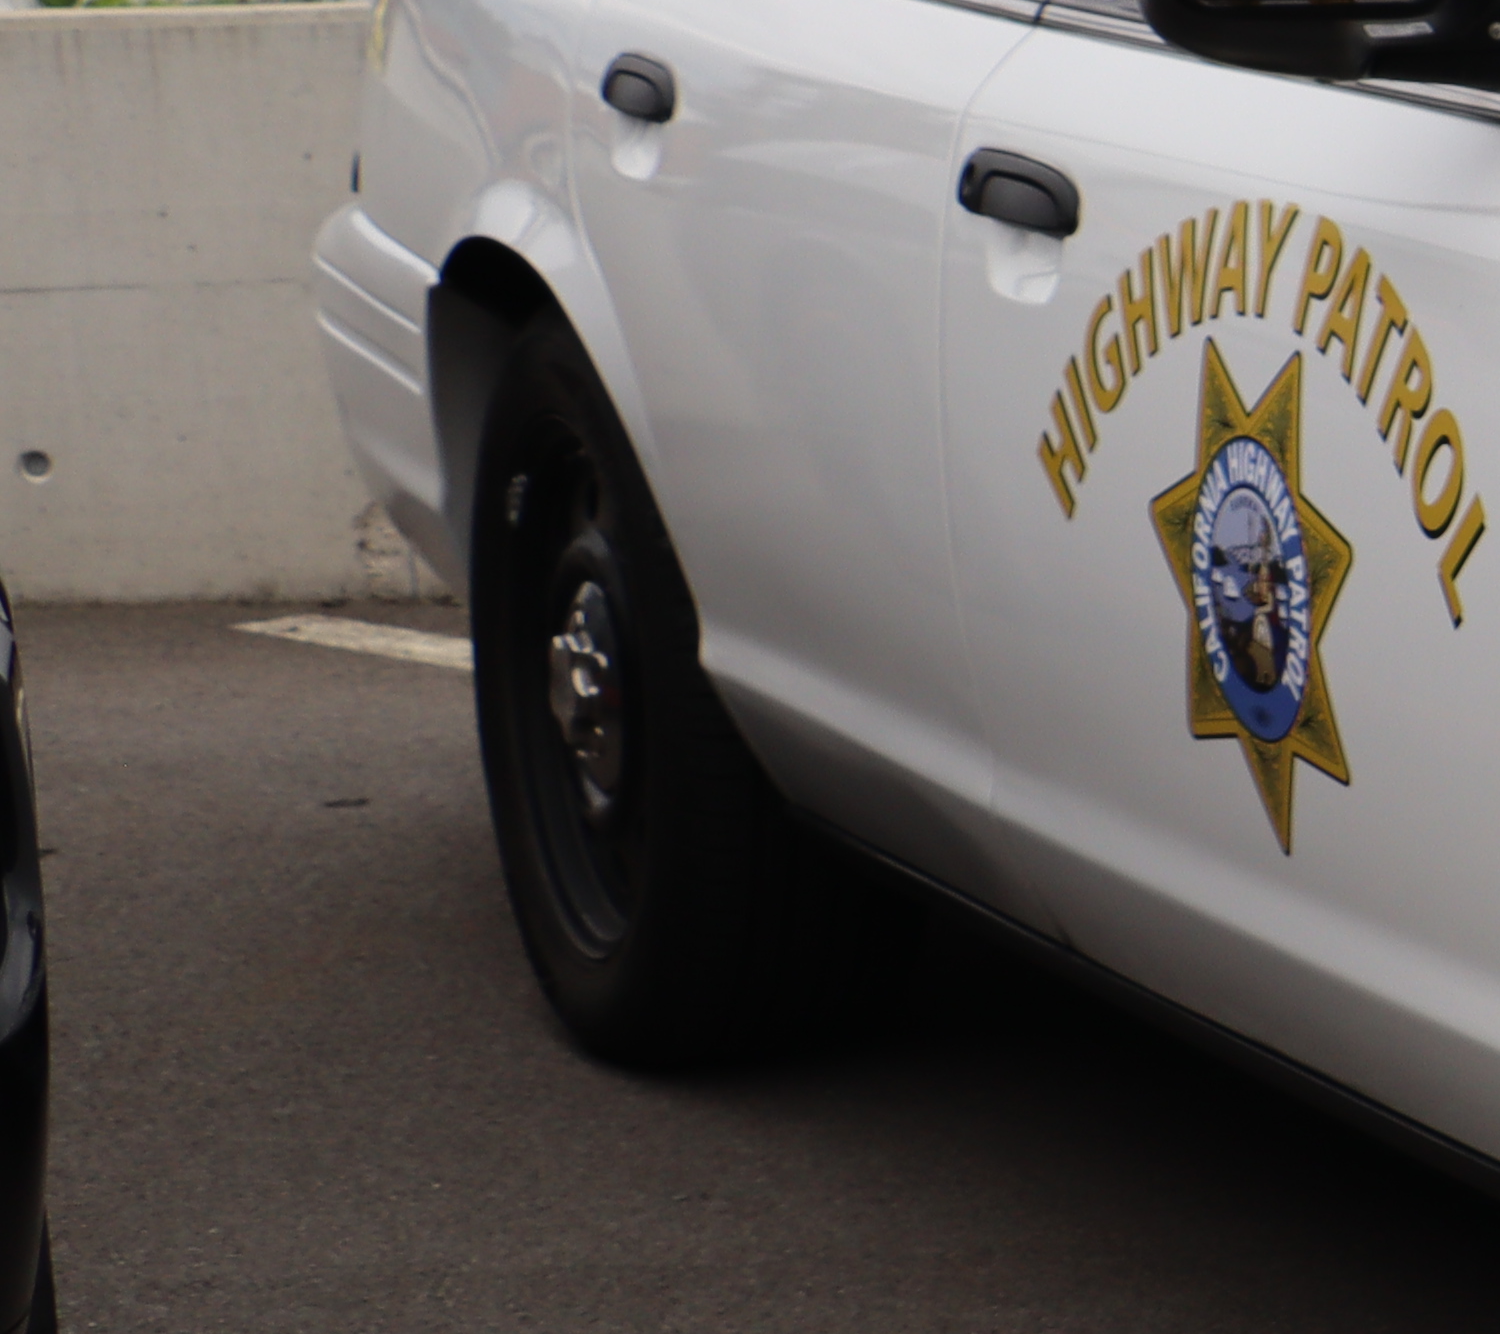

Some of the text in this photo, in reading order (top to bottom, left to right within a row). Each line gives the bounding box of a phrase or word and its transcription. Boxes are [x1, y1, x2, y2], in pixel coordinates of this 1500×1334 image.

[1036, 198, 1486, 629] HIGHWAY PATROL
[1192, 457, 1229, 683] CALIFORNIA
[1226, 439, 1299, 543] HIGHWAY
[1280, 554, 1310, 702] PATROL
